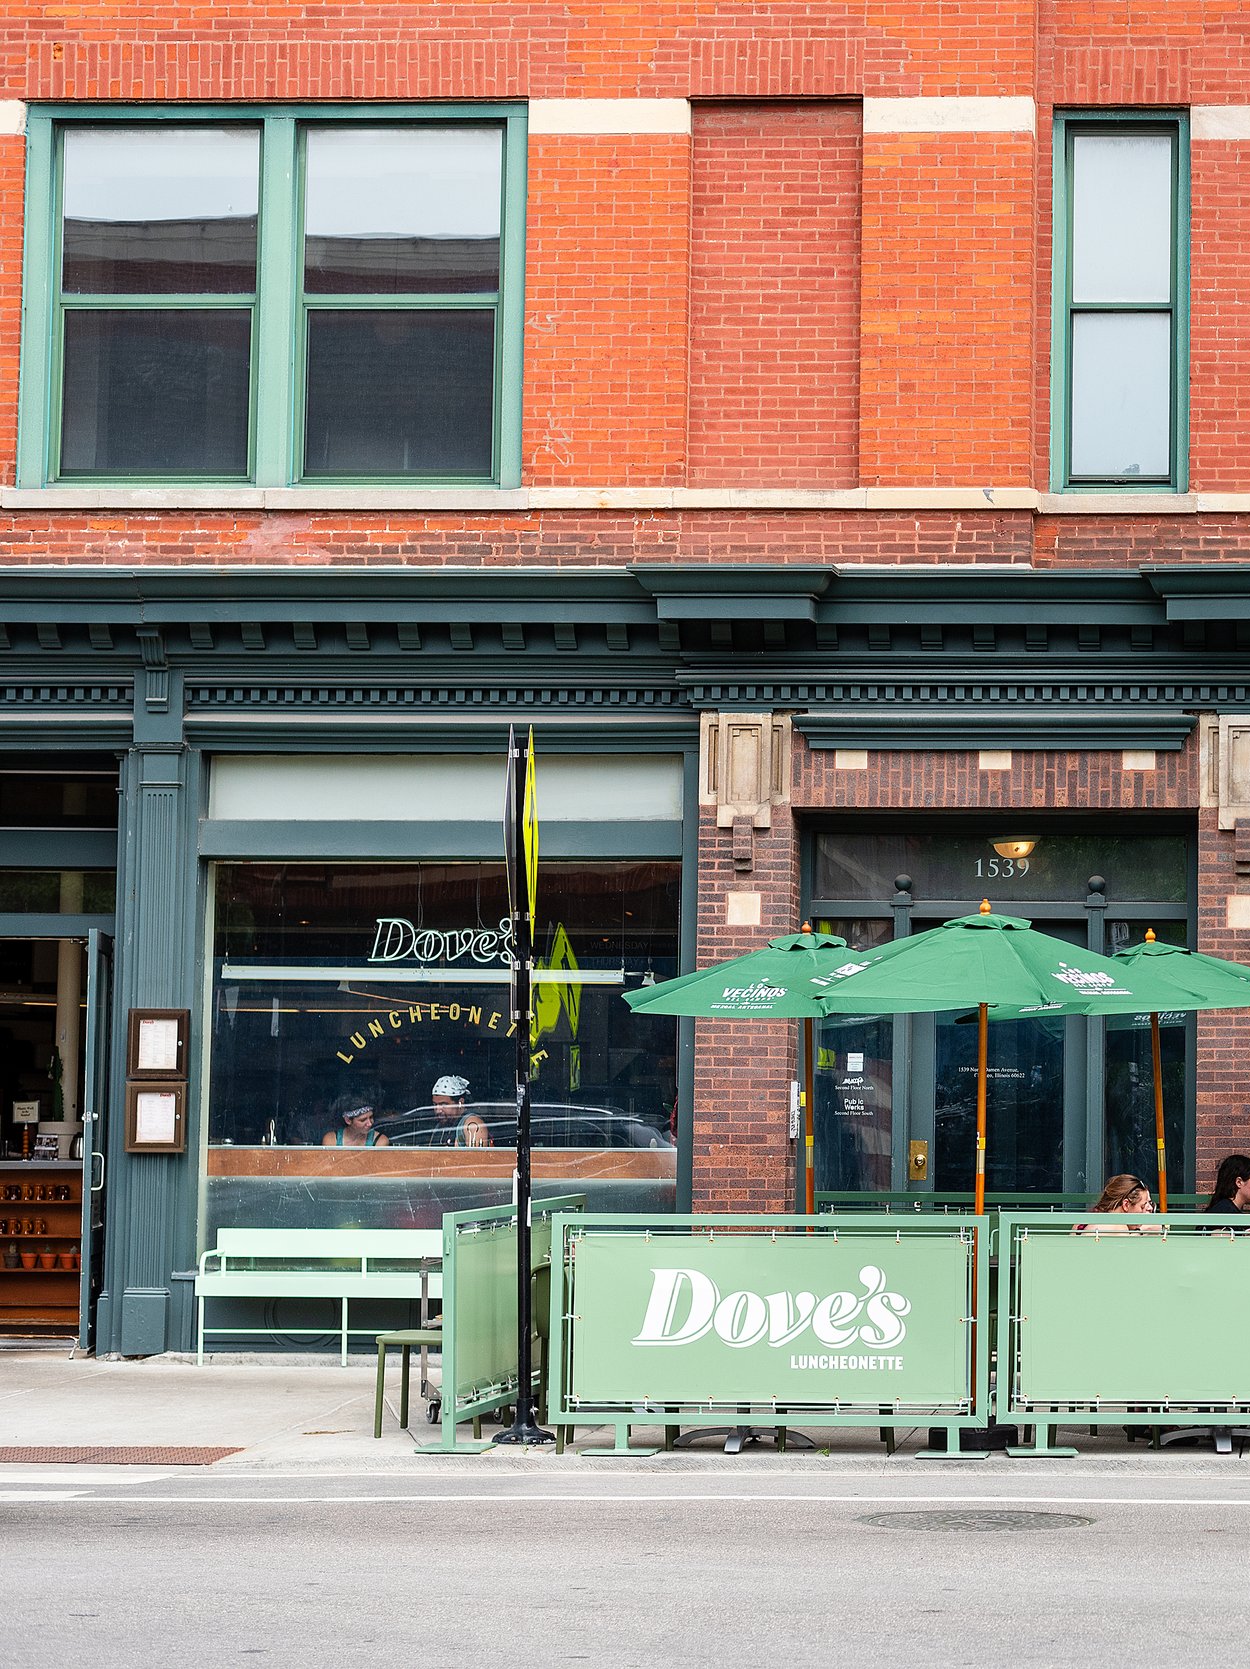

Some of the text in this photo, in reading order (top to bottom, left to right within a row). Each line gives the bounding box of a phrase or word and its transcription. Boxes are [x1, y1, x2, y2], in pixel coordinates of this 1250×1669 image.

[974, 858, 1030, 878] 1539
[722, 987, 788, 998] VECINOS
[336, 1003, 549, 1065] LUNCHEONETE
[630, 1265, 912, 1349] Dove's
[790, 1354, 904, 1370] LUNCHEONETTE
